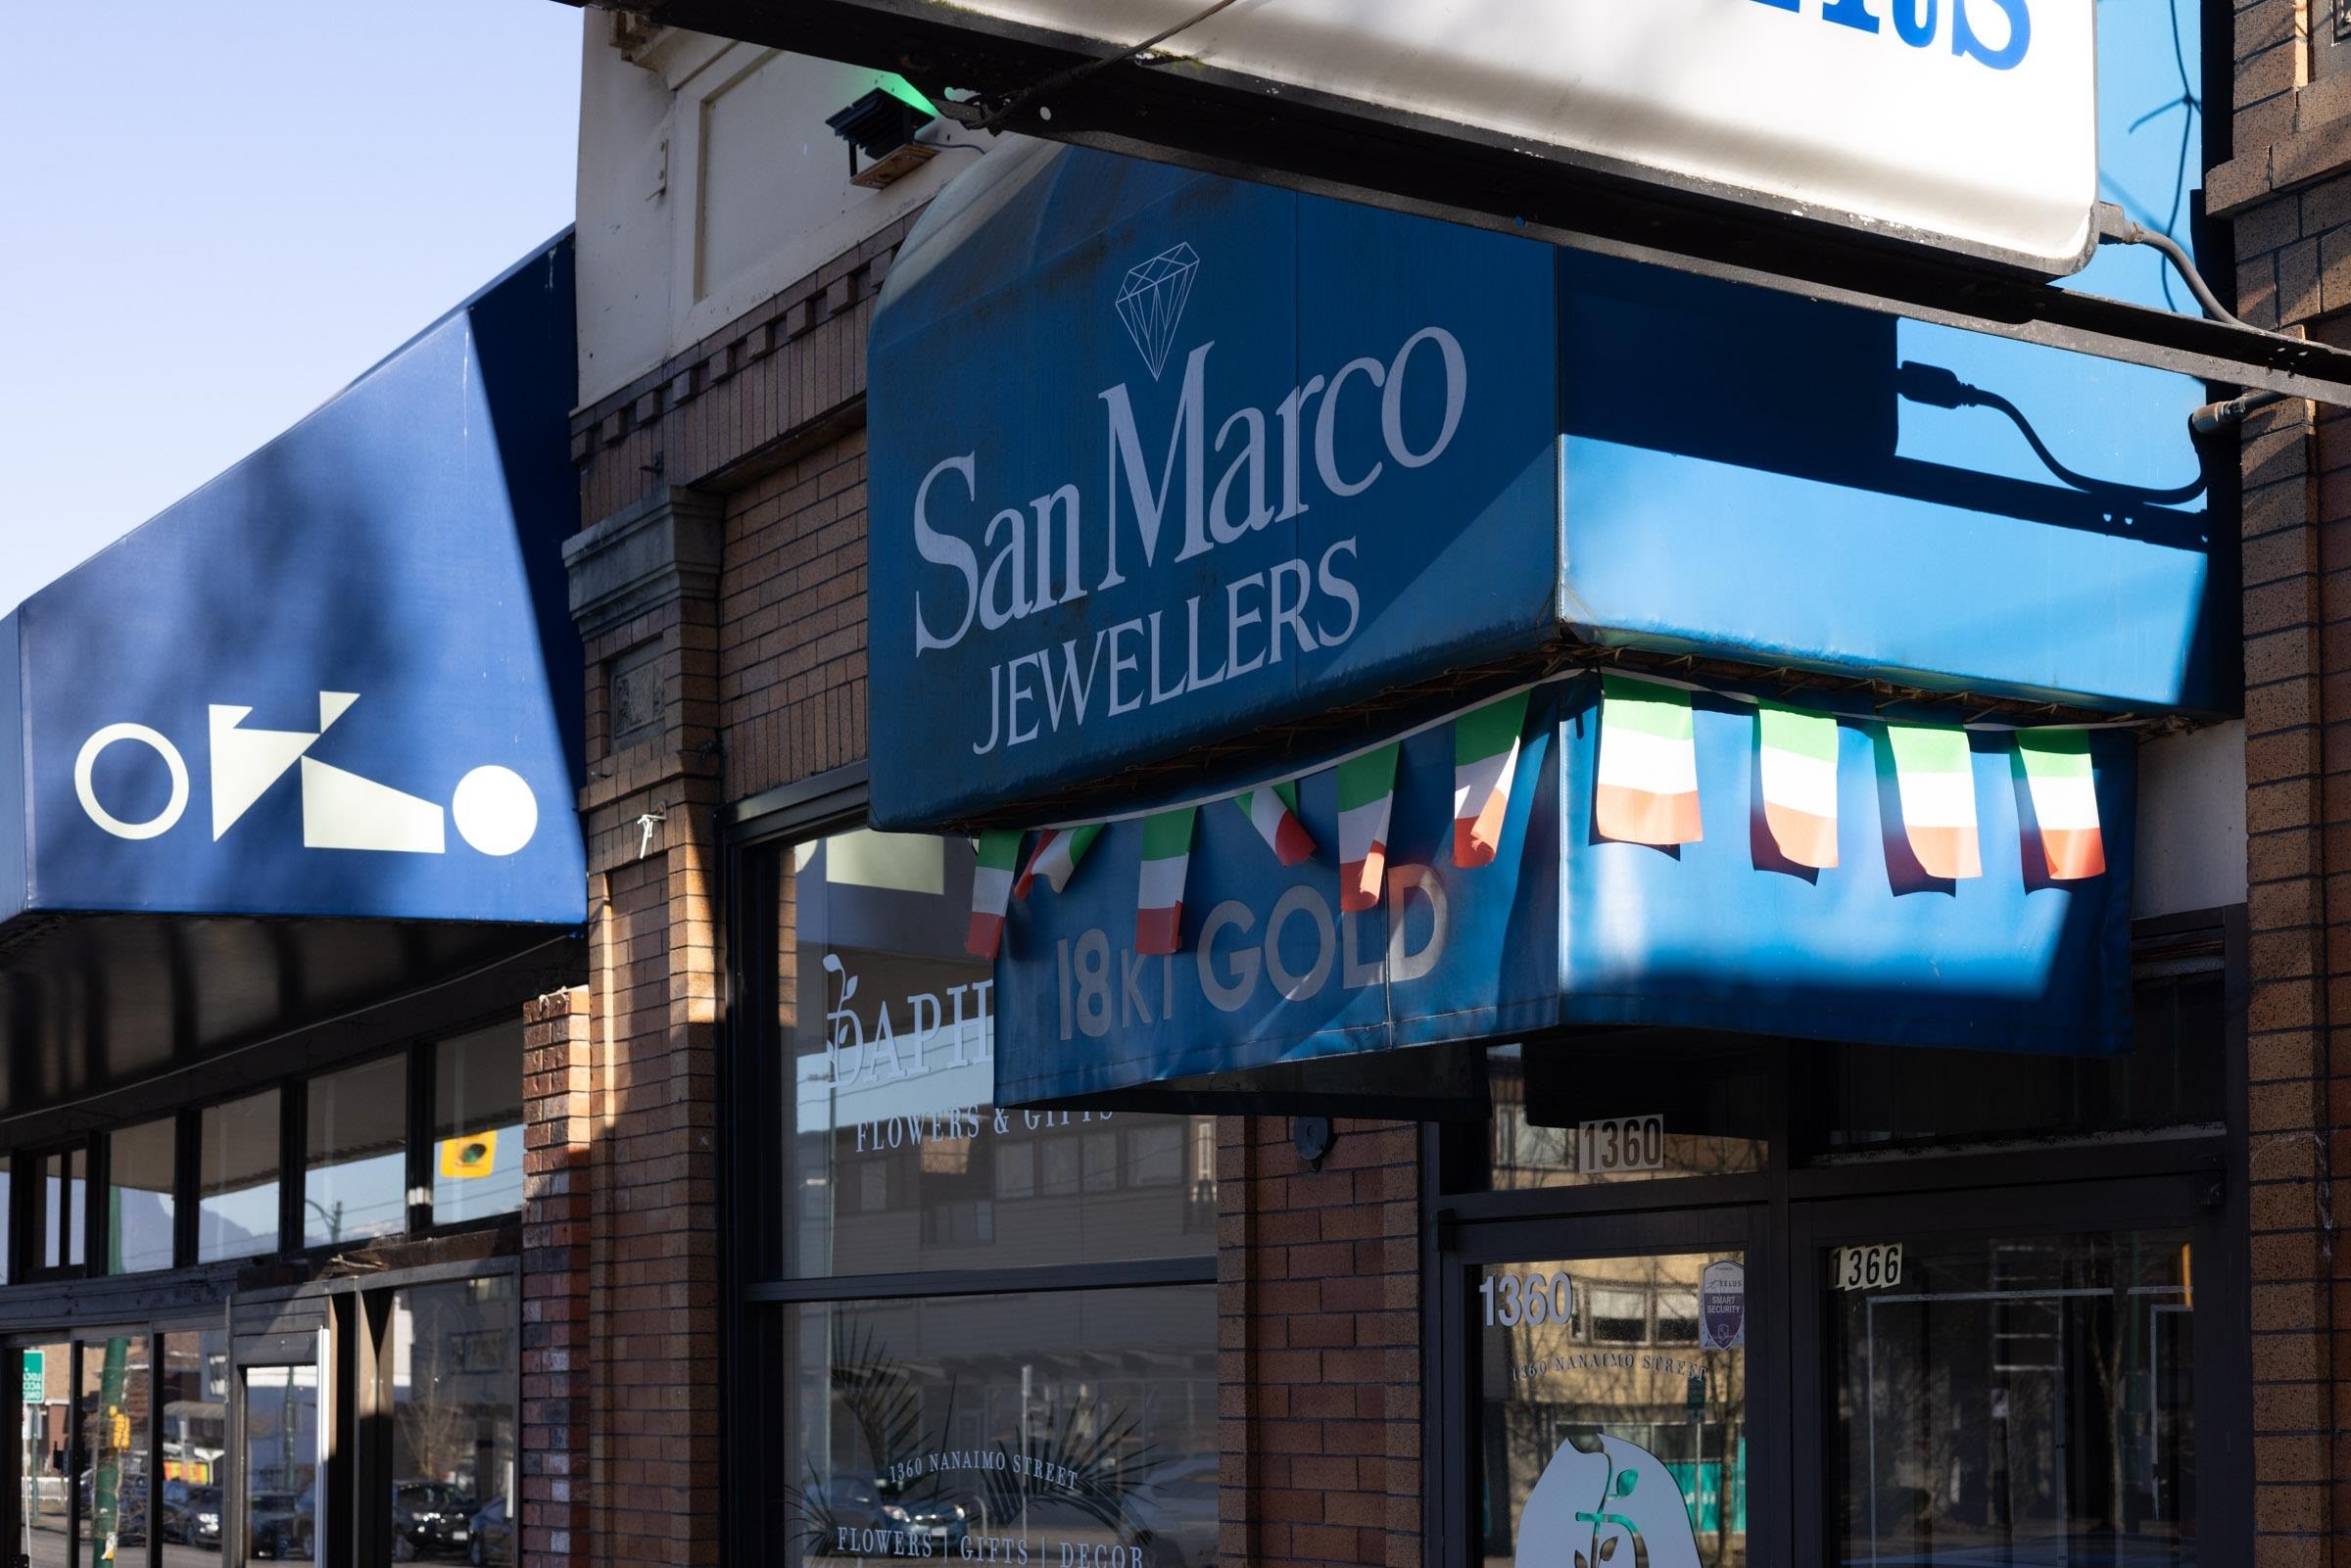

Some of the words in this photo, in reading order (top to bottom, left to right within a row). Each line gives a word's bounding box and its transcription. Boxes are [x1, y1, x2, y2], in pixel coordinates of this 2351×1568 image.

[914, 451, 1087, 658] San
[1098, 326, 1467, 592] Marco
[973, 536, 1360, 755] JEWELLERS
[1197, 863, 1448, 1013] GOLD
[855, 1105, 979, 1153] FLOWERS
[1584, 1117, 1661, 1170] 1360
[1833, 1246, 1899, 1286] 1366
[1479, 1271, 1572, 1326] 1360
[1707, 1305, 1741, 1313] SECURITY
[1555, 1353, 1635, 1372] NANAIMO
[1643, 1355, 1708, 1382] STREET
[889, 1456, 923, 1484] 1360
[931, 1450, 1006, 1472] NANAIMO
[1013, 1454, 1078, 1491] STREET
[837, 1526, 932, 1558] FLOWERS
[960, 1535, 1029, 1565] GIFTS
[1060, 1542, 1144, 1568] DECOR
